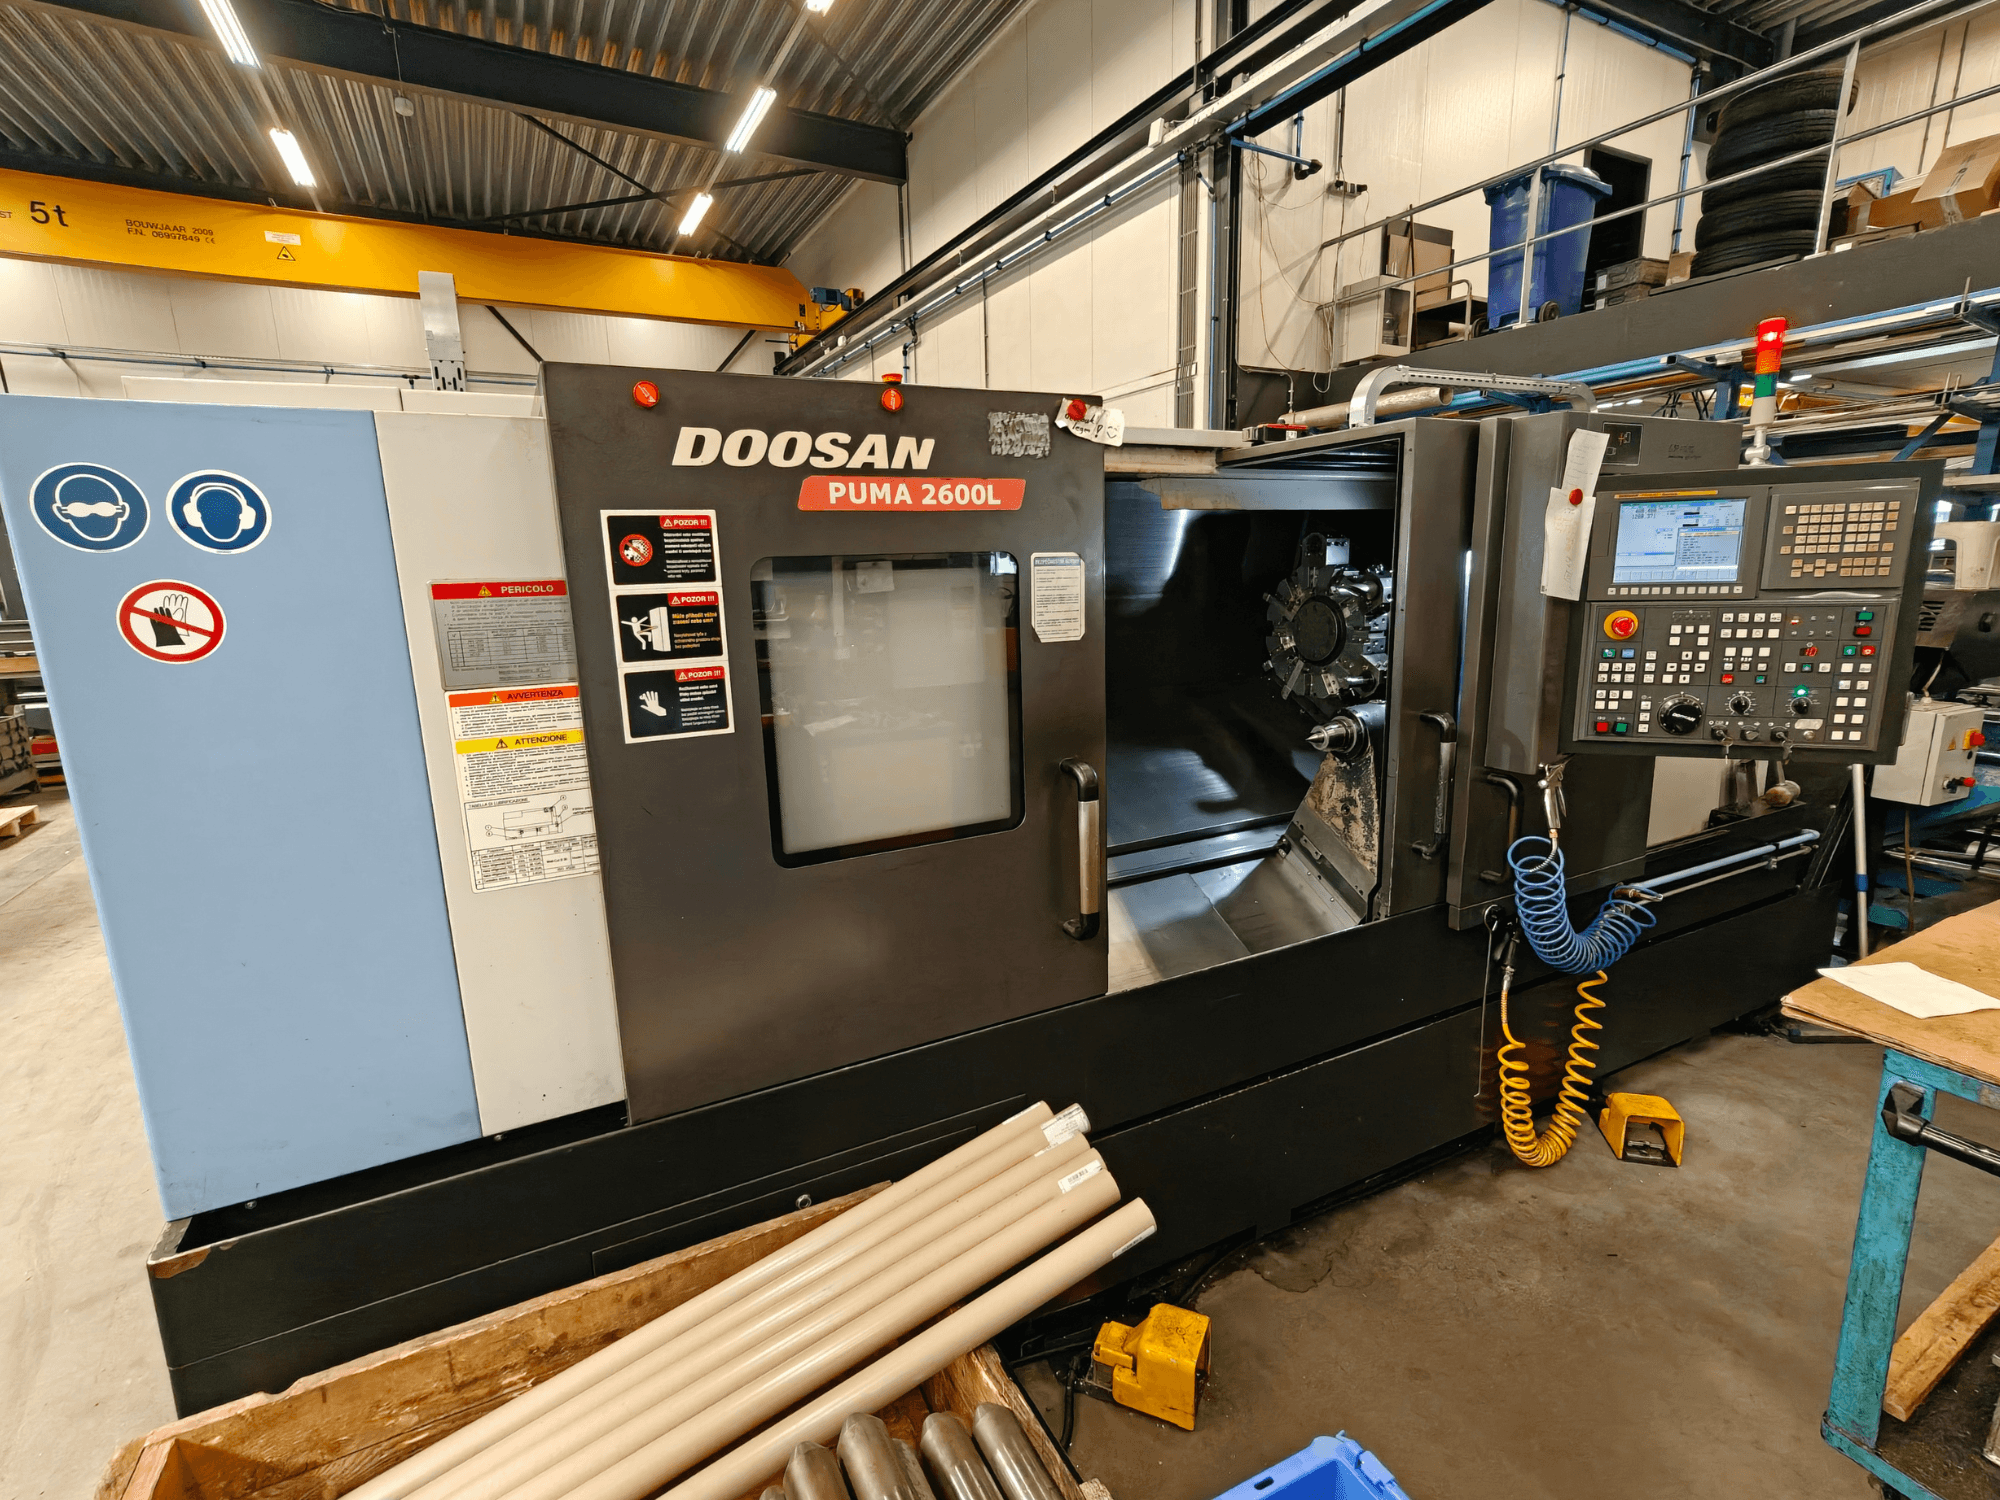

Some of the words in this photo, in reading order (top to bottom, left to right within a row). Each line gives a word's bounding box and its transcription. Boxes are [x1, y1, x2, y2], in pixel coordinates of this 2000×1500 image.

[125, 219, 186, 233] BOUWJAAR
[192, 227, 214, 236] 2009
[671, 427, 935, 470] DOOSAN
[828, 482, 913, 505] PUMA
[921, 484, 1001, 506] 2600L
[501, 584, 554, 594] PERICOLO
[688, 671, 713, 679] POZOR
[507, 690, 564, 700] AVVERTENZA
[515, 734, 568, 745] ATTENZIONE
